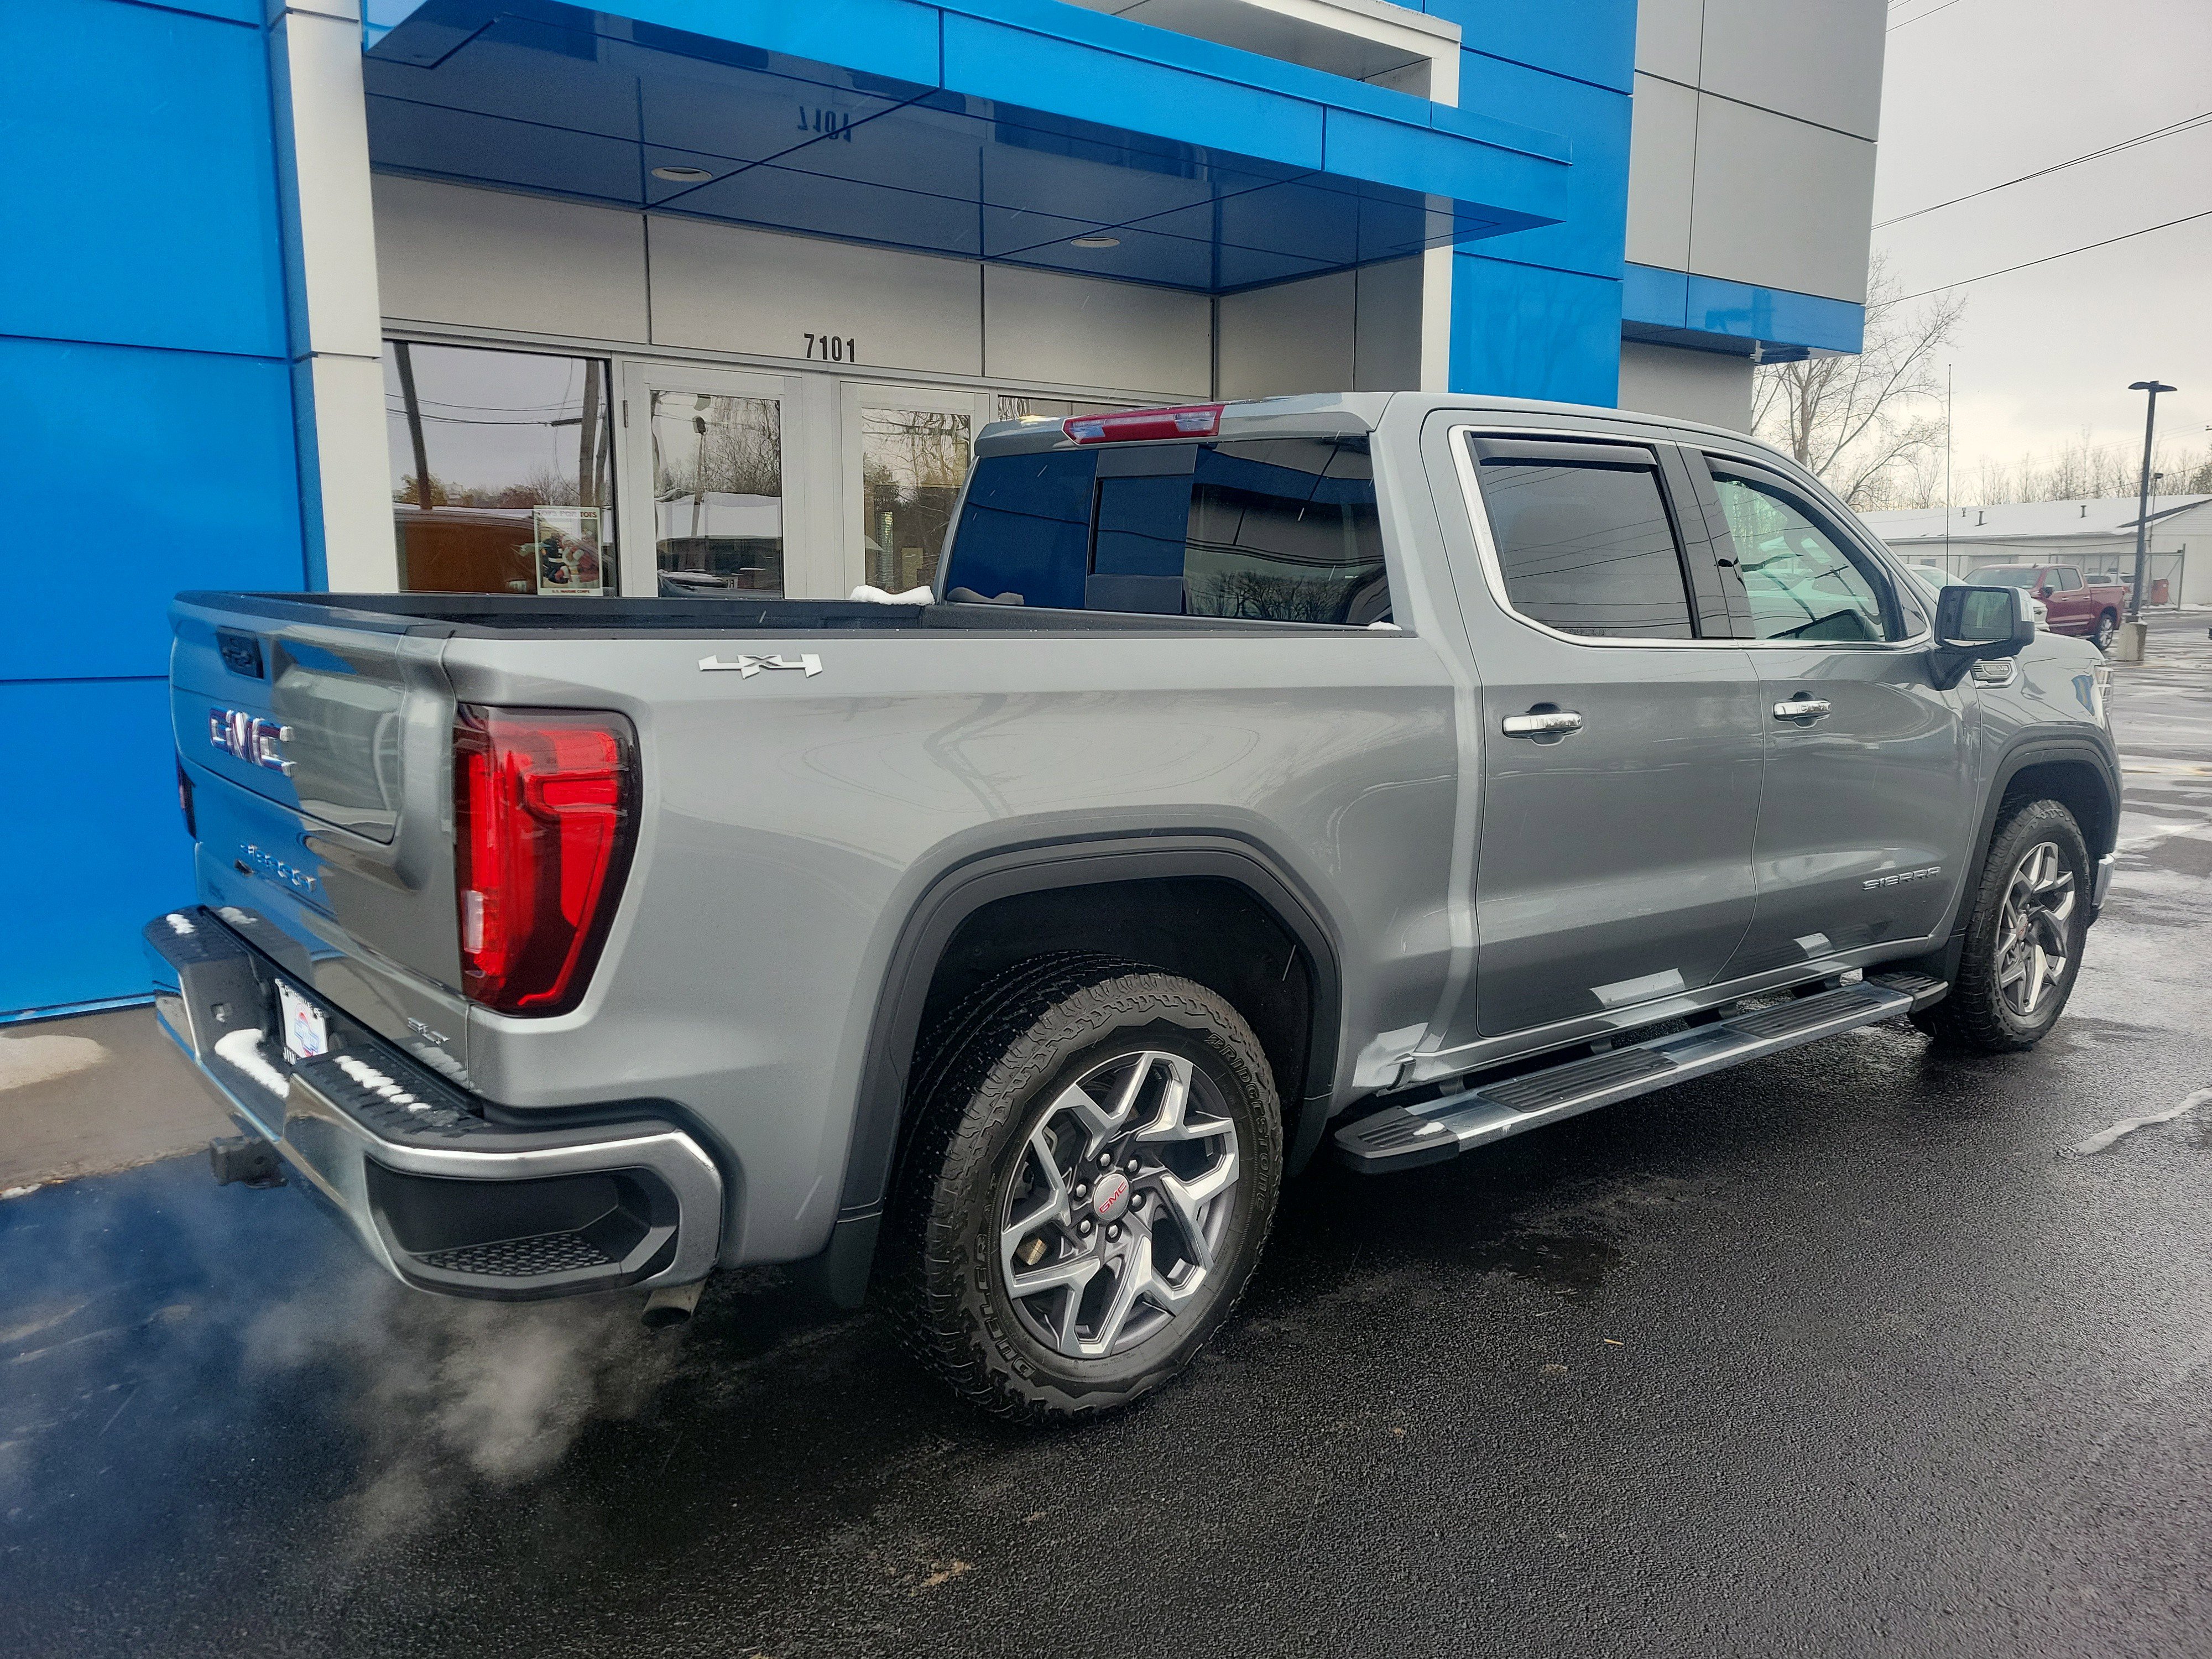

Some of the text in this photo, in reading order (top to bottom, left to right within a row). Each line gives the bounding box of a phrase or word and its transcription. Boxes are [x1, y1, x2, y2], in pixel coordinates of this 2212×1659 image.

[804, 333, 855, 363] 7101
[209, 705, 299, 779] GMC
[1862, 866, 1942, 890] SIERRA
[1204, 1032, 1270, 1211] BRIDGESTONE
[1099, 1181, 1127, 1213] GMC
[974, 1234, 1036, 1380] DUELER
